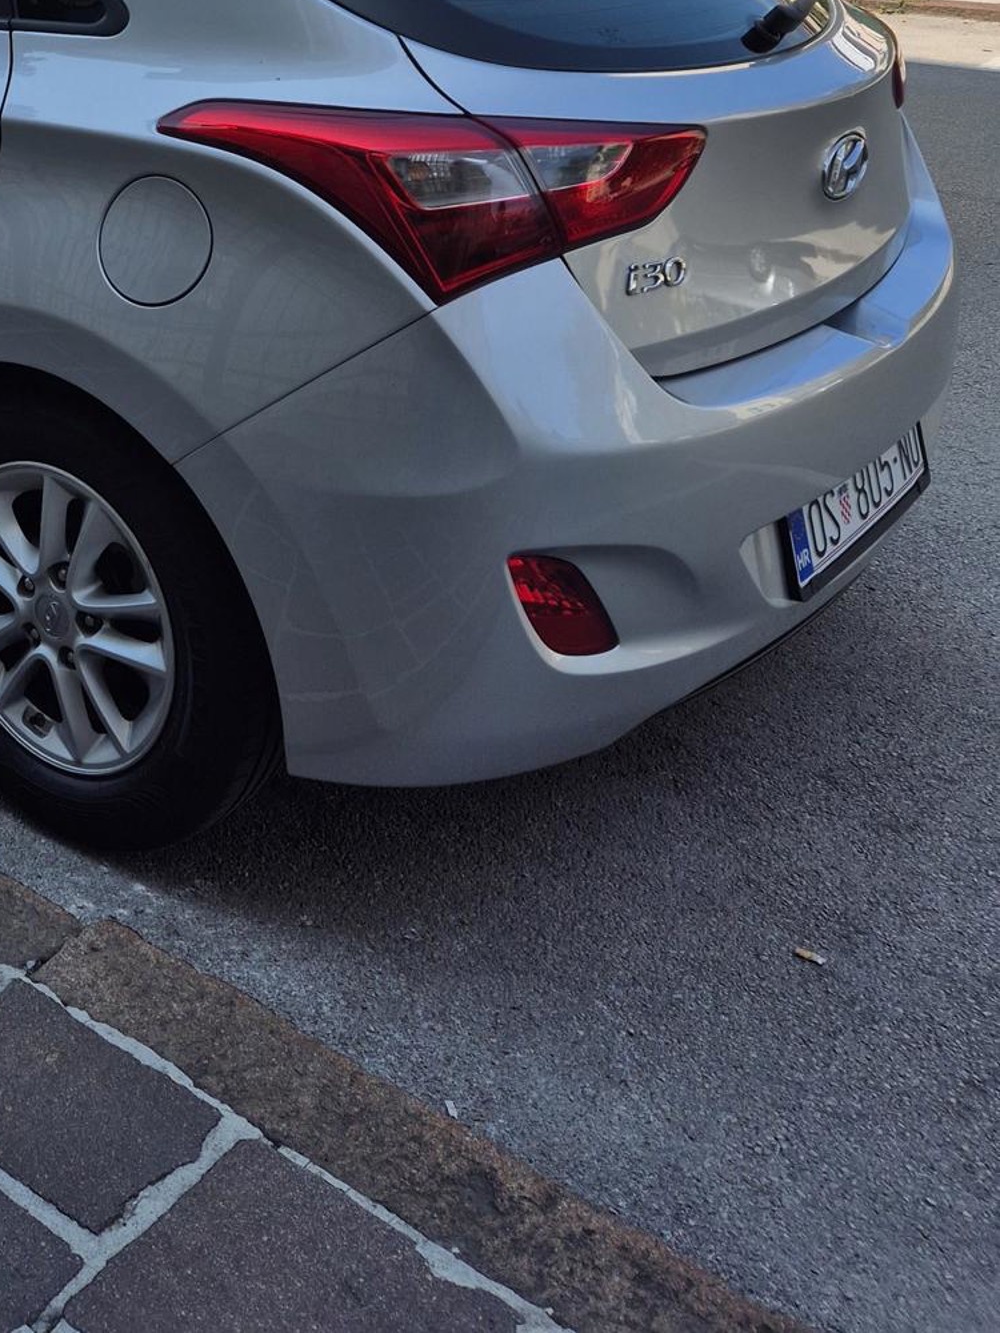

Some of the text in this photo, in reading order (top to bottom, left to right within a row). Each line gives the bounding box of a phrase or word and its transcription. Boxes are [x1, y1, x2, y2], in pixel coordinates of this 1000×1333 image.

[625, 257, 687, 296] i30
[808, 489, 842, 558] OS
[796, 548, 811, 571] HR
